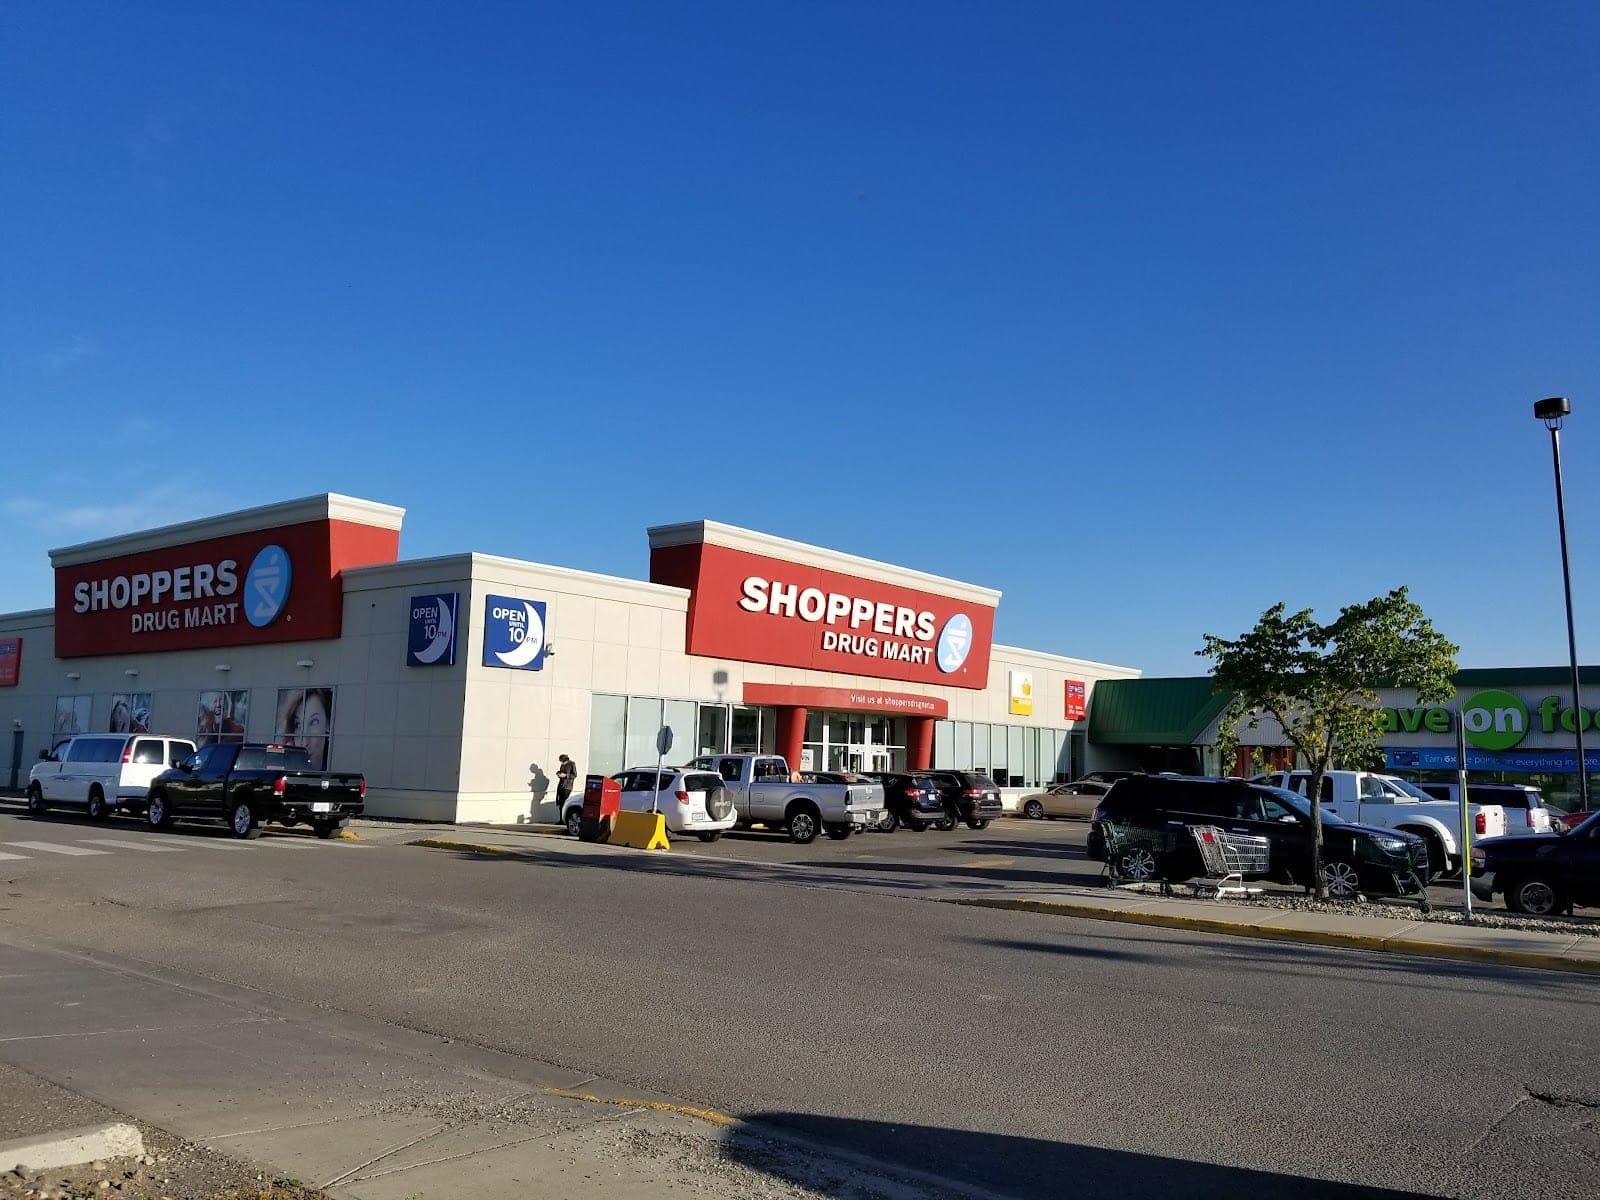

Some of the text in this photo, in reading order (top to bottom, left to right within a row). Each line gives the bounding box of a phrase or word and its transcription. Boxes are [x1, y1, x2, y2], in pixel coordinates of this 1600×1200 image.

[73, 559, 238, 614] SHOPPERS
[131, 602, 240, 634] DRUG MART
[412, 607, 438, 620] OPEN
[492, 607, 526, 622] OPEN
[738, 576, 936, 642] SHOPPERS
[423, 624, 437, 640] 10
[508, 620, 525, 629] UNTIL
[508, 626, 538, 645] 10 PM
[822, 631, 934, 666] DRUG MART
[1376, 696, 1600, 733] ave on fo
[1443, 755, 1457, 764] 6x
[1514, 758, 1562, 768] everything
